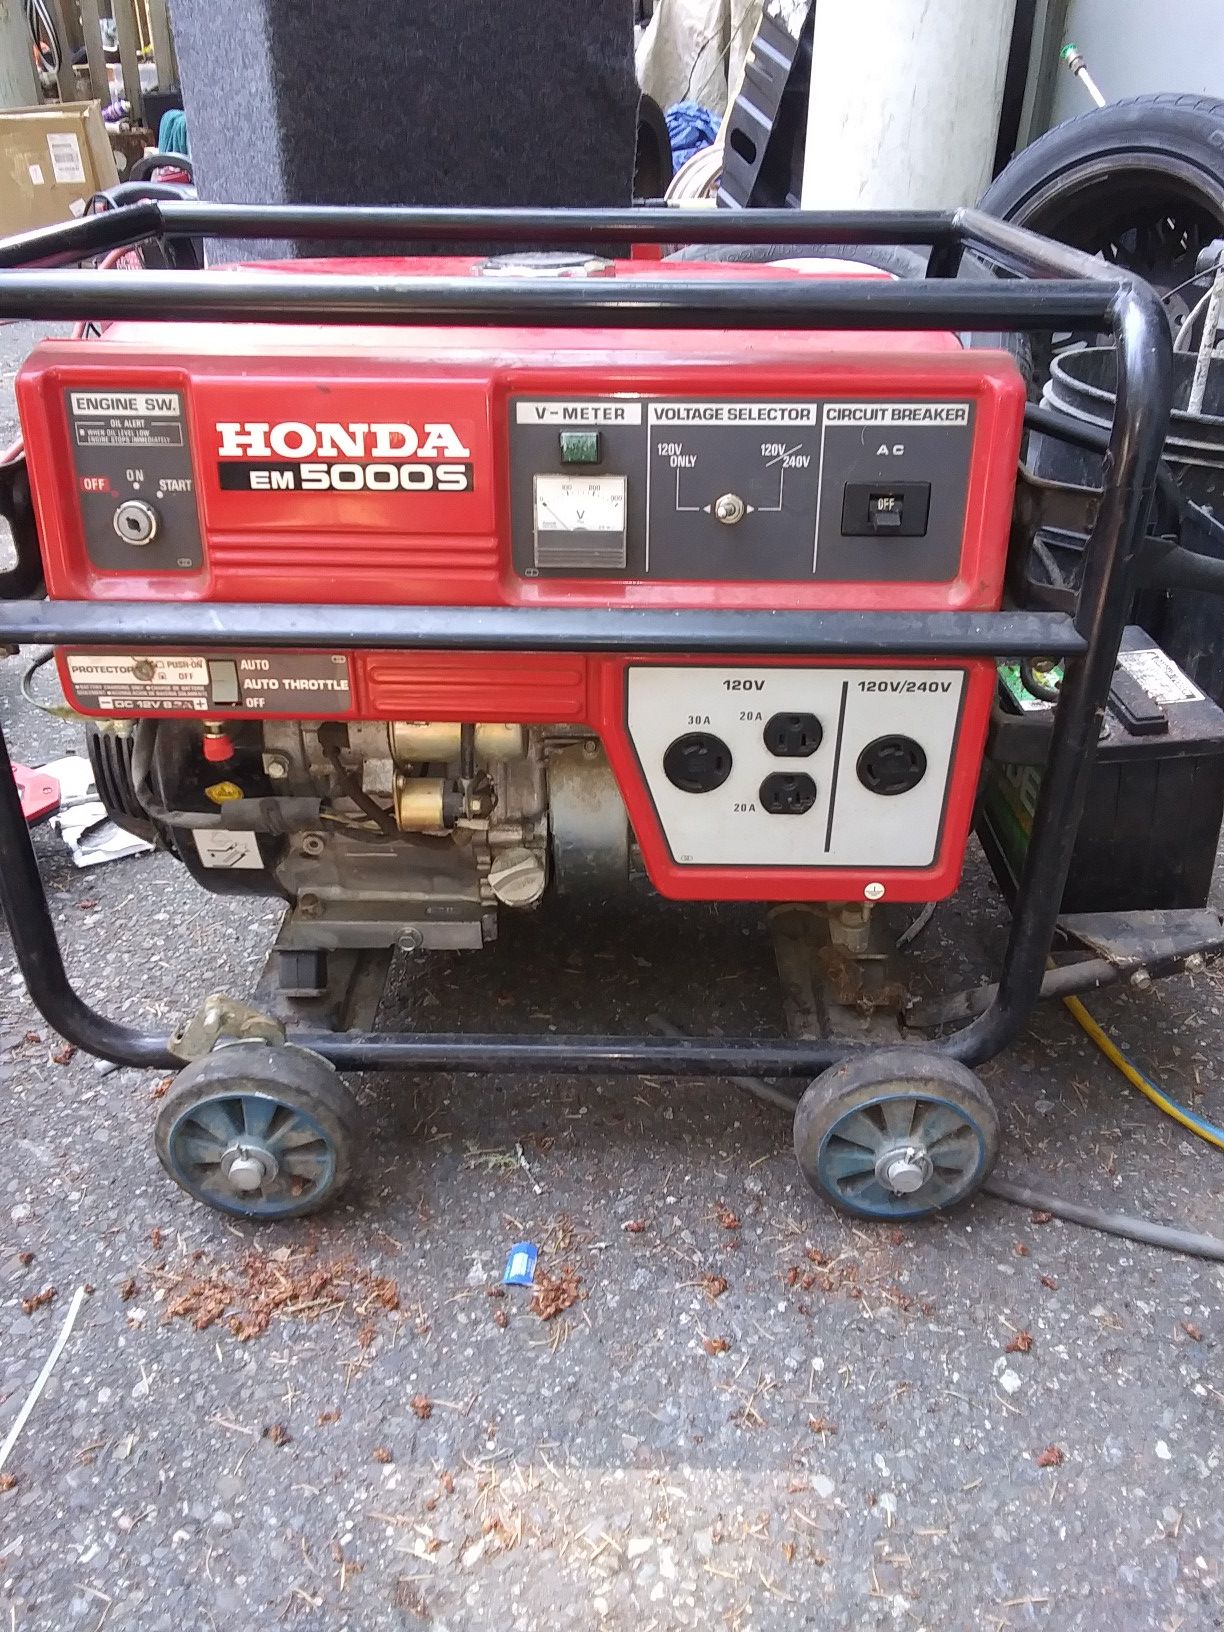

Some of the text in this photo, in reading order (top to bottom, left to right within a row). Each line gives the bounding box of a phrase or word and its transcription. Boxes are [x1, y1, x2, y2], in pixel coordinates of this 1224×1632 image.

[76, 397, 176, 411] ENGINE SW.
[654, 407, 811, 421] VOLTAGE SELECTOR
[826, 408, 966, 421] CIRCUIT BREAKER
[110, 419, 145, 428] OIL ALERT
[216, 421, 470, 458] HONDA
[657, 443, 682, 456] 120V
[670, 455, 697, 468] ONLY
[126, 469, 144, 482] ON
[83, 478, 104, 490] OFF
[159, 479, 191, 491] START
[877, 498, 895, 511] OFF
[576, 509, 585, 520] V
[240, 659, 270, 671] AUTO
[243, 678, 349, 691] AUTO THROTTLE
[722, 679, 766, 691] 120V
[857, 680, 952, 693] 120V/240V
[245, 697, 266, 708] OFF
